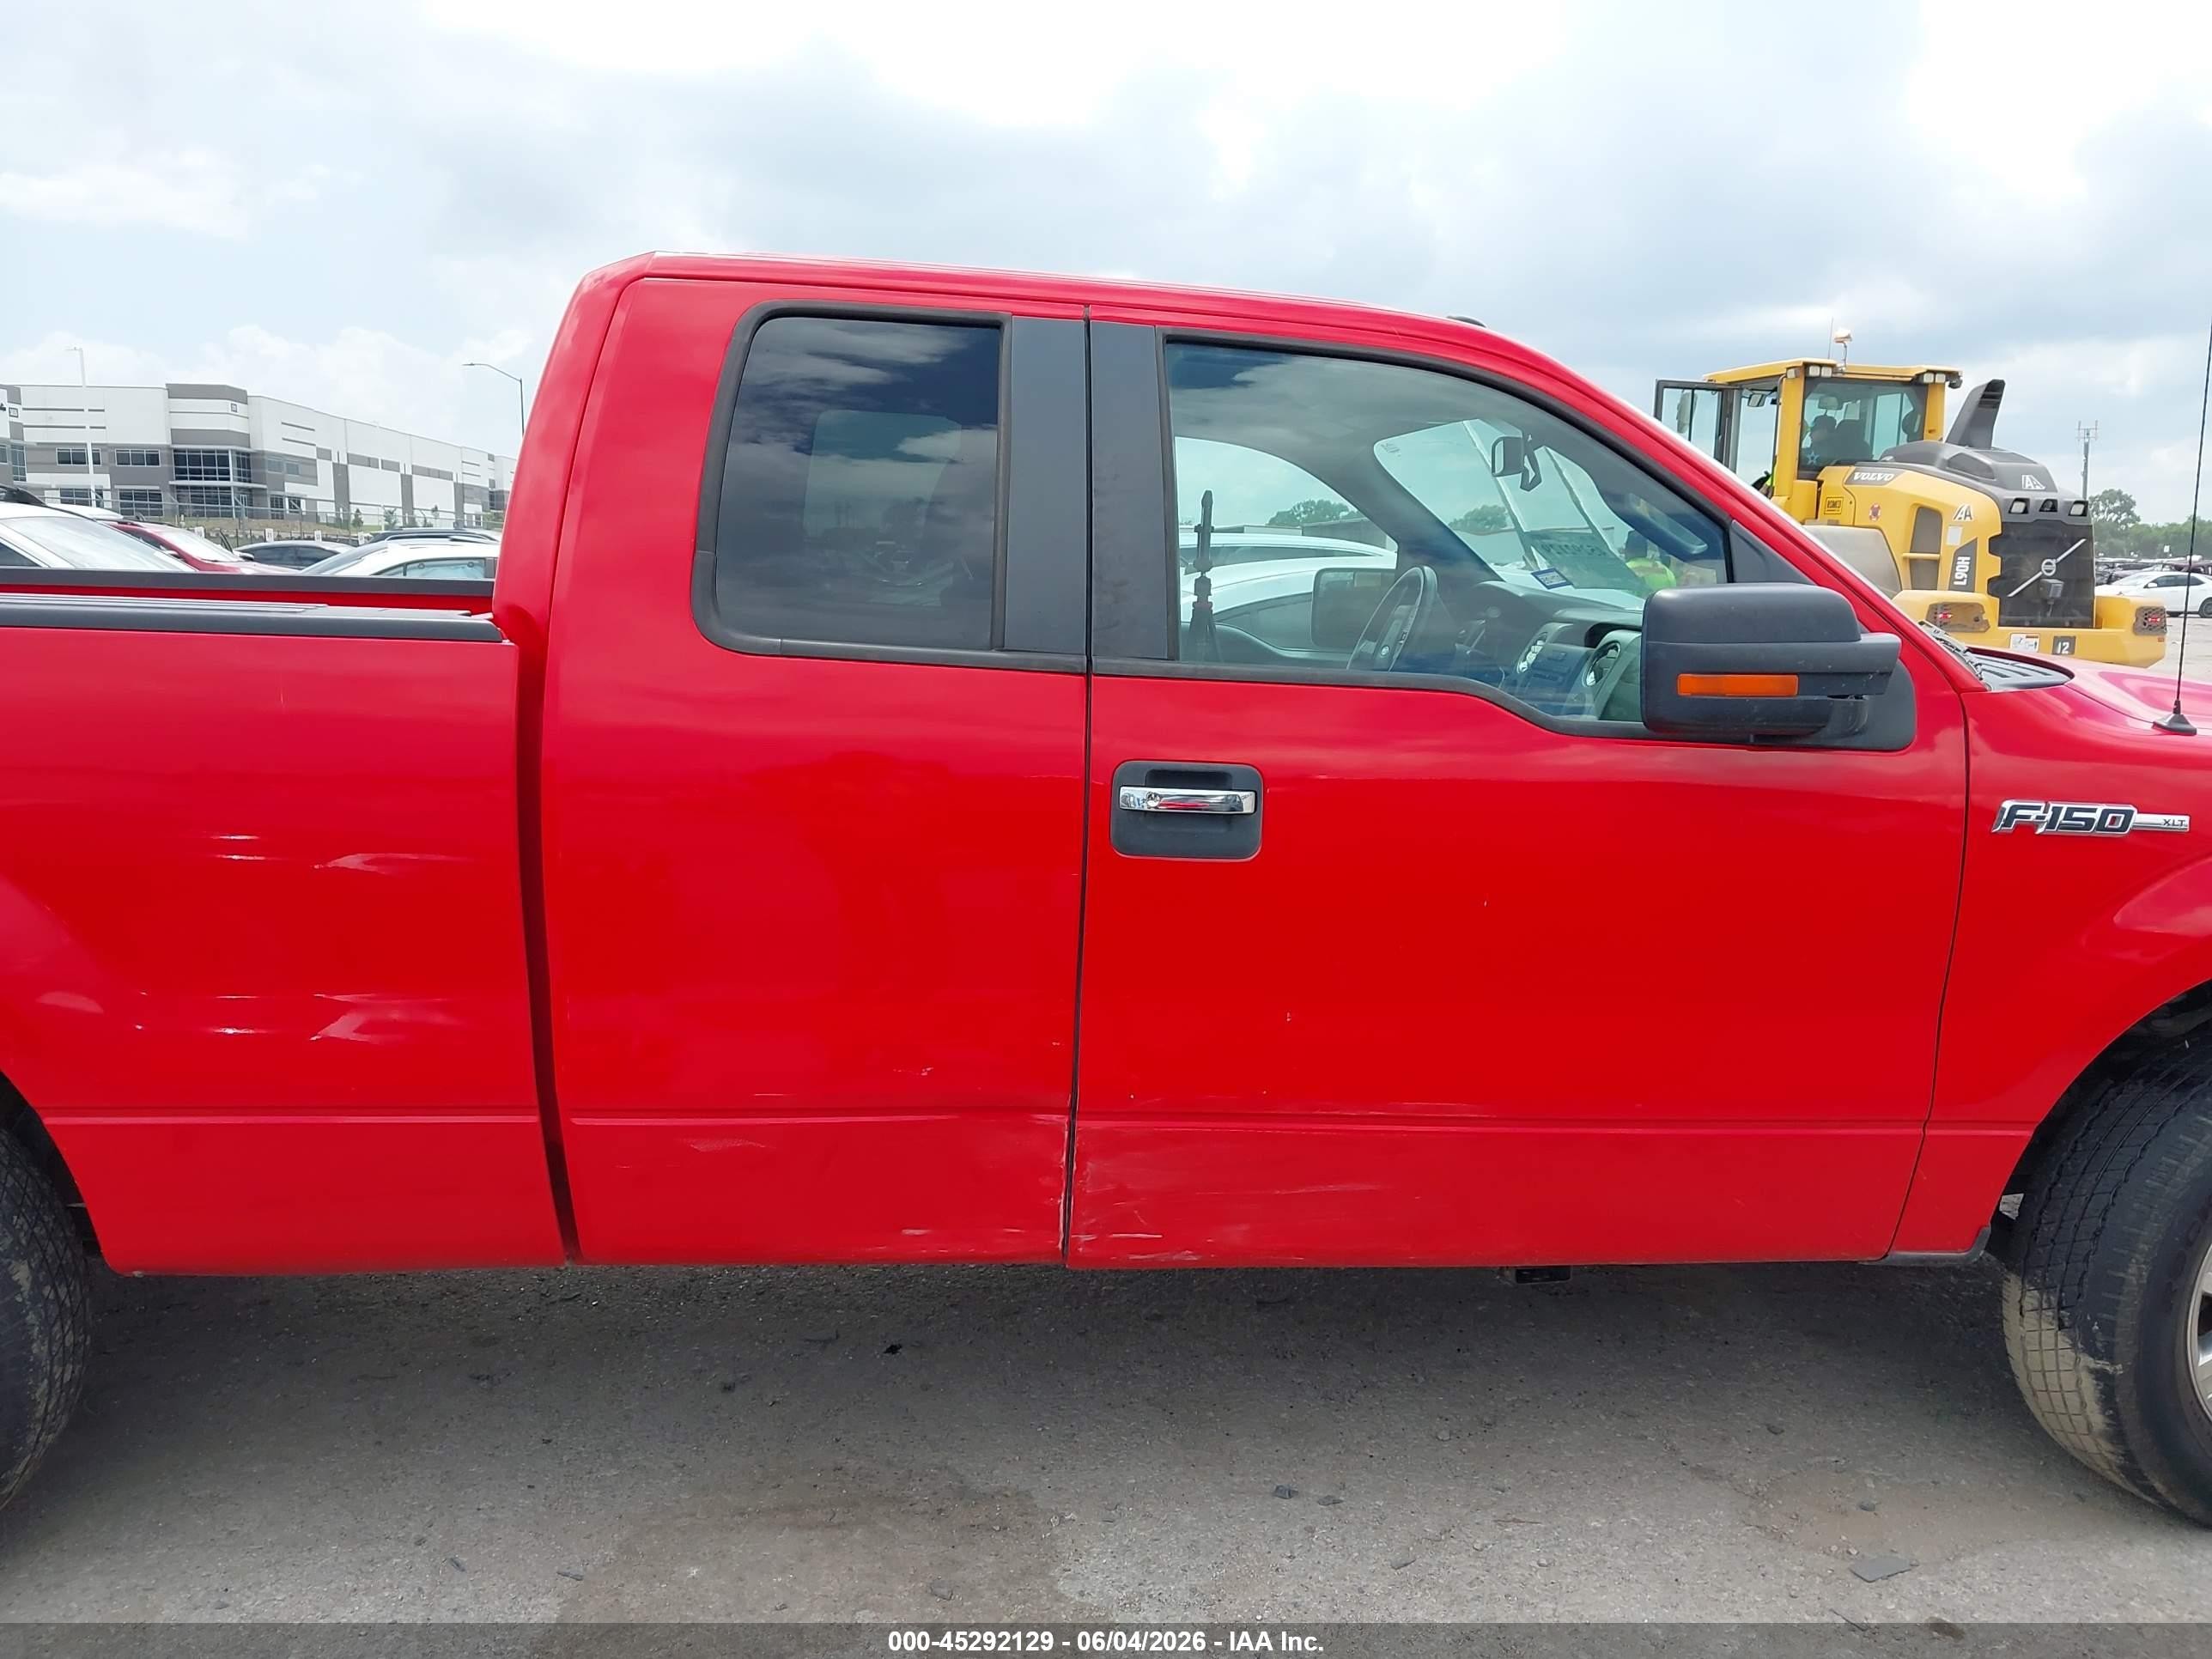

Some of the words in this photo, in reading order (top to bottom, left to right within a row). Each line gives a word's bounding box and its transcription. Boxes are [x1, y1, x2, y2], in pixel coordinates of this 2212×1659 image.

[1853, 471, 1895, 482] VOLVO
[1953, 556, 1972, 586] L90H
[2057, 641, 2070, 654] 12
[1991, 799, 2138, 836] F-150
[2162, 818, 2186, 827] XLT
